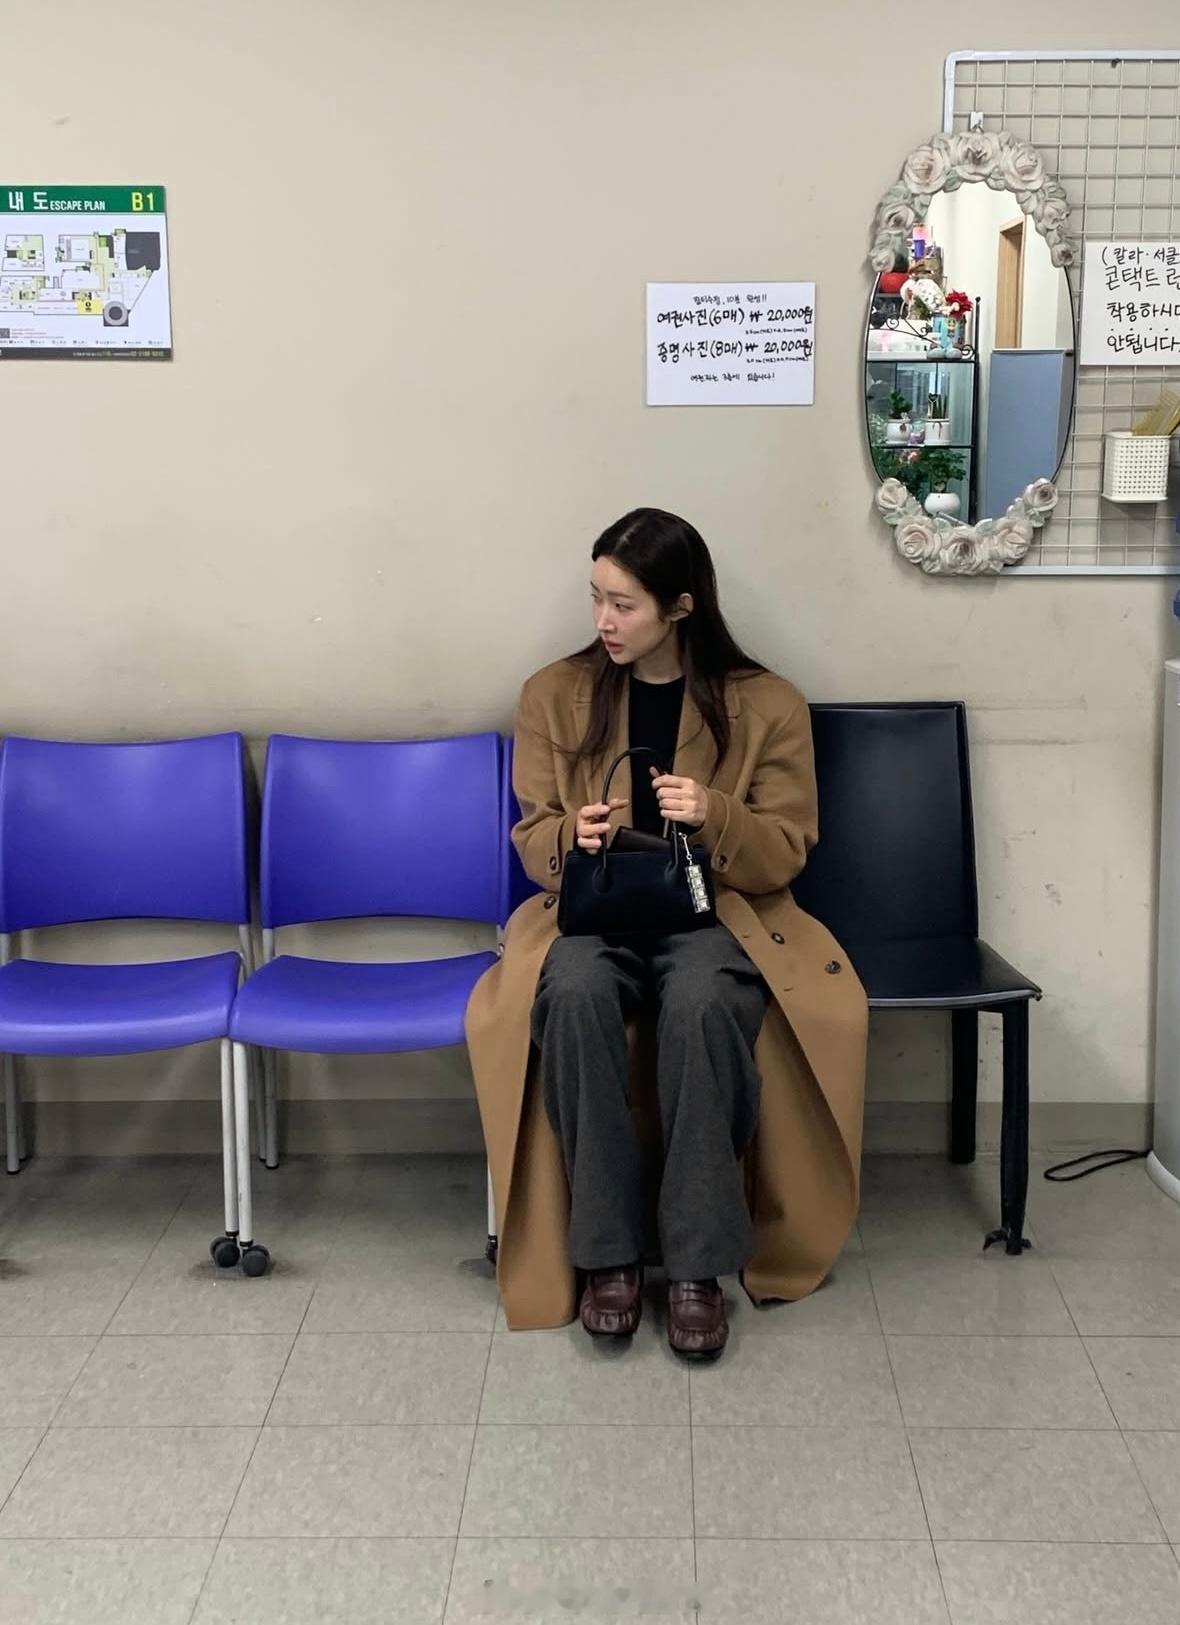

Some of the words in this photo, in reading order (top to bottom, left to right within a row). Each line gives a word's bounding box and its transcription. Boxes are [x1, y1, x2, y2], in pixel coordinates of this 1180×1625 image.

[33, 191, 49, 210] 도
[50, 200, 83, 211] ESCAPE
[84, 200, 106, 211] PLAN
[131, 191, 155, 211] B1
[1105, 265, 1161, 292] 콘택트
[657, 308, 745, 328] 여권사진(6매)
[767, 306, 813, 325] 20,000원
[764, 339, 813, 358] 20,000원
